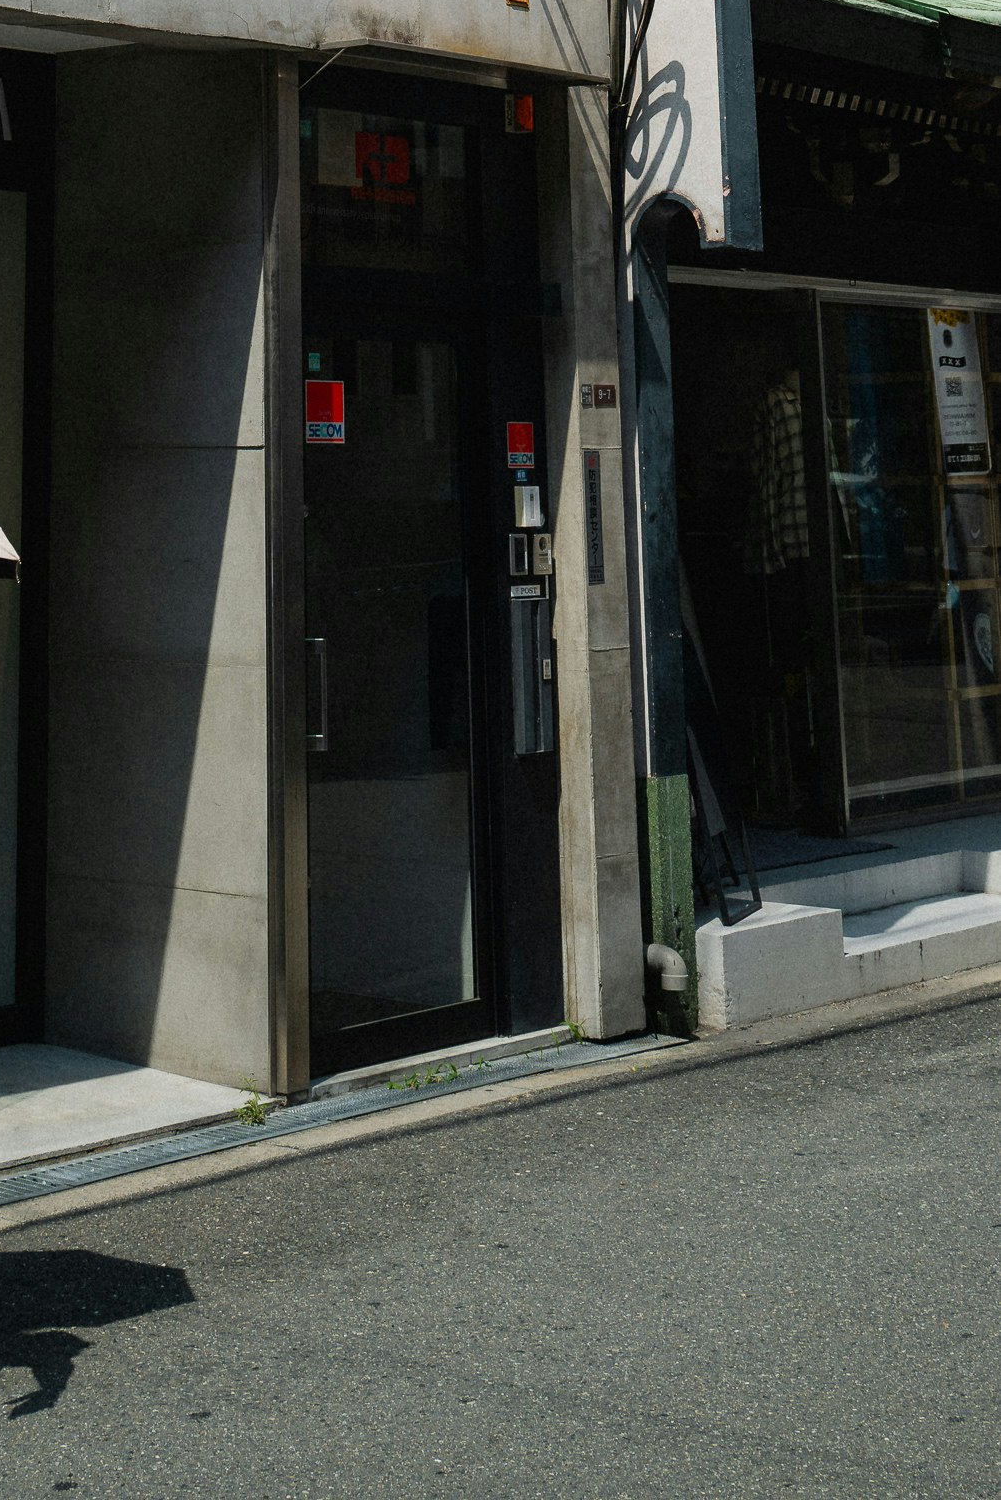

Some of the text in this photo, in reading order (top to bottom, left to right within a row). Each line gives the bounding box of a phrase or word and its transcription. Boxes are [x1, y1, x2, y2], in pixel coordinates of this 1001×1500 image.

[599, 389, 611, 400] 9-7
[308, 423, 342, 438] SECOM
[509, 453, 533, 464] SECOM
[520, 587, 538, 595] POST
